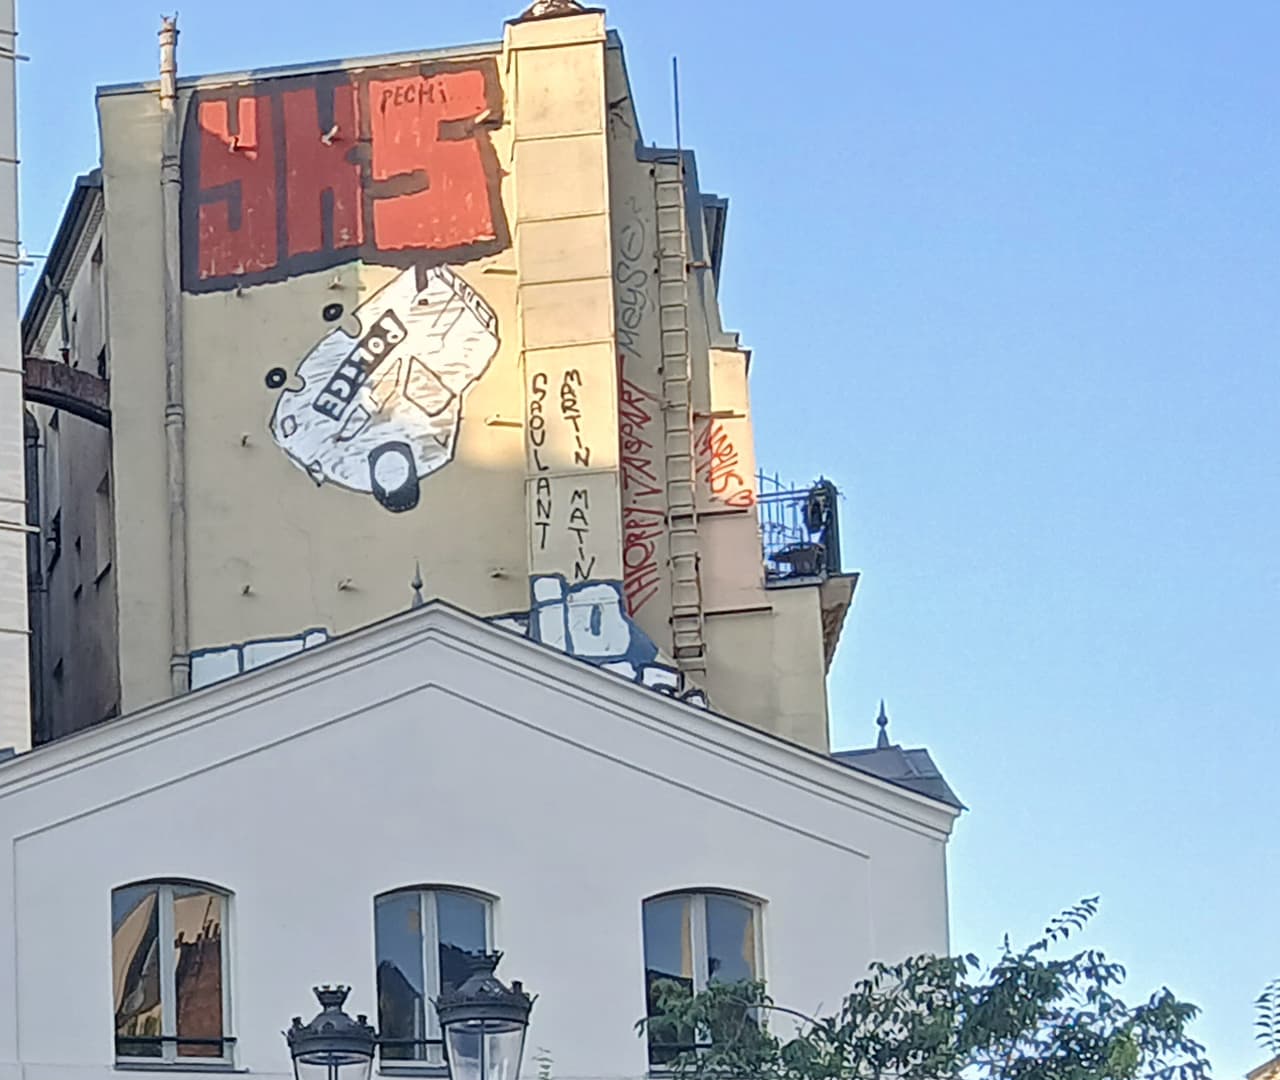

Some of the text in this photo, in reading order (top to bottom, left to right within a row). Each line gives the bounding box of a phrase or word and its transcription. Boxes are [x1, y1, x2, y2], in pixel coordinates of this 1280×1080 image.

[314, 312, 408, 419] POLICE
[561, 369, 596, 581] MARTIN MATIN
